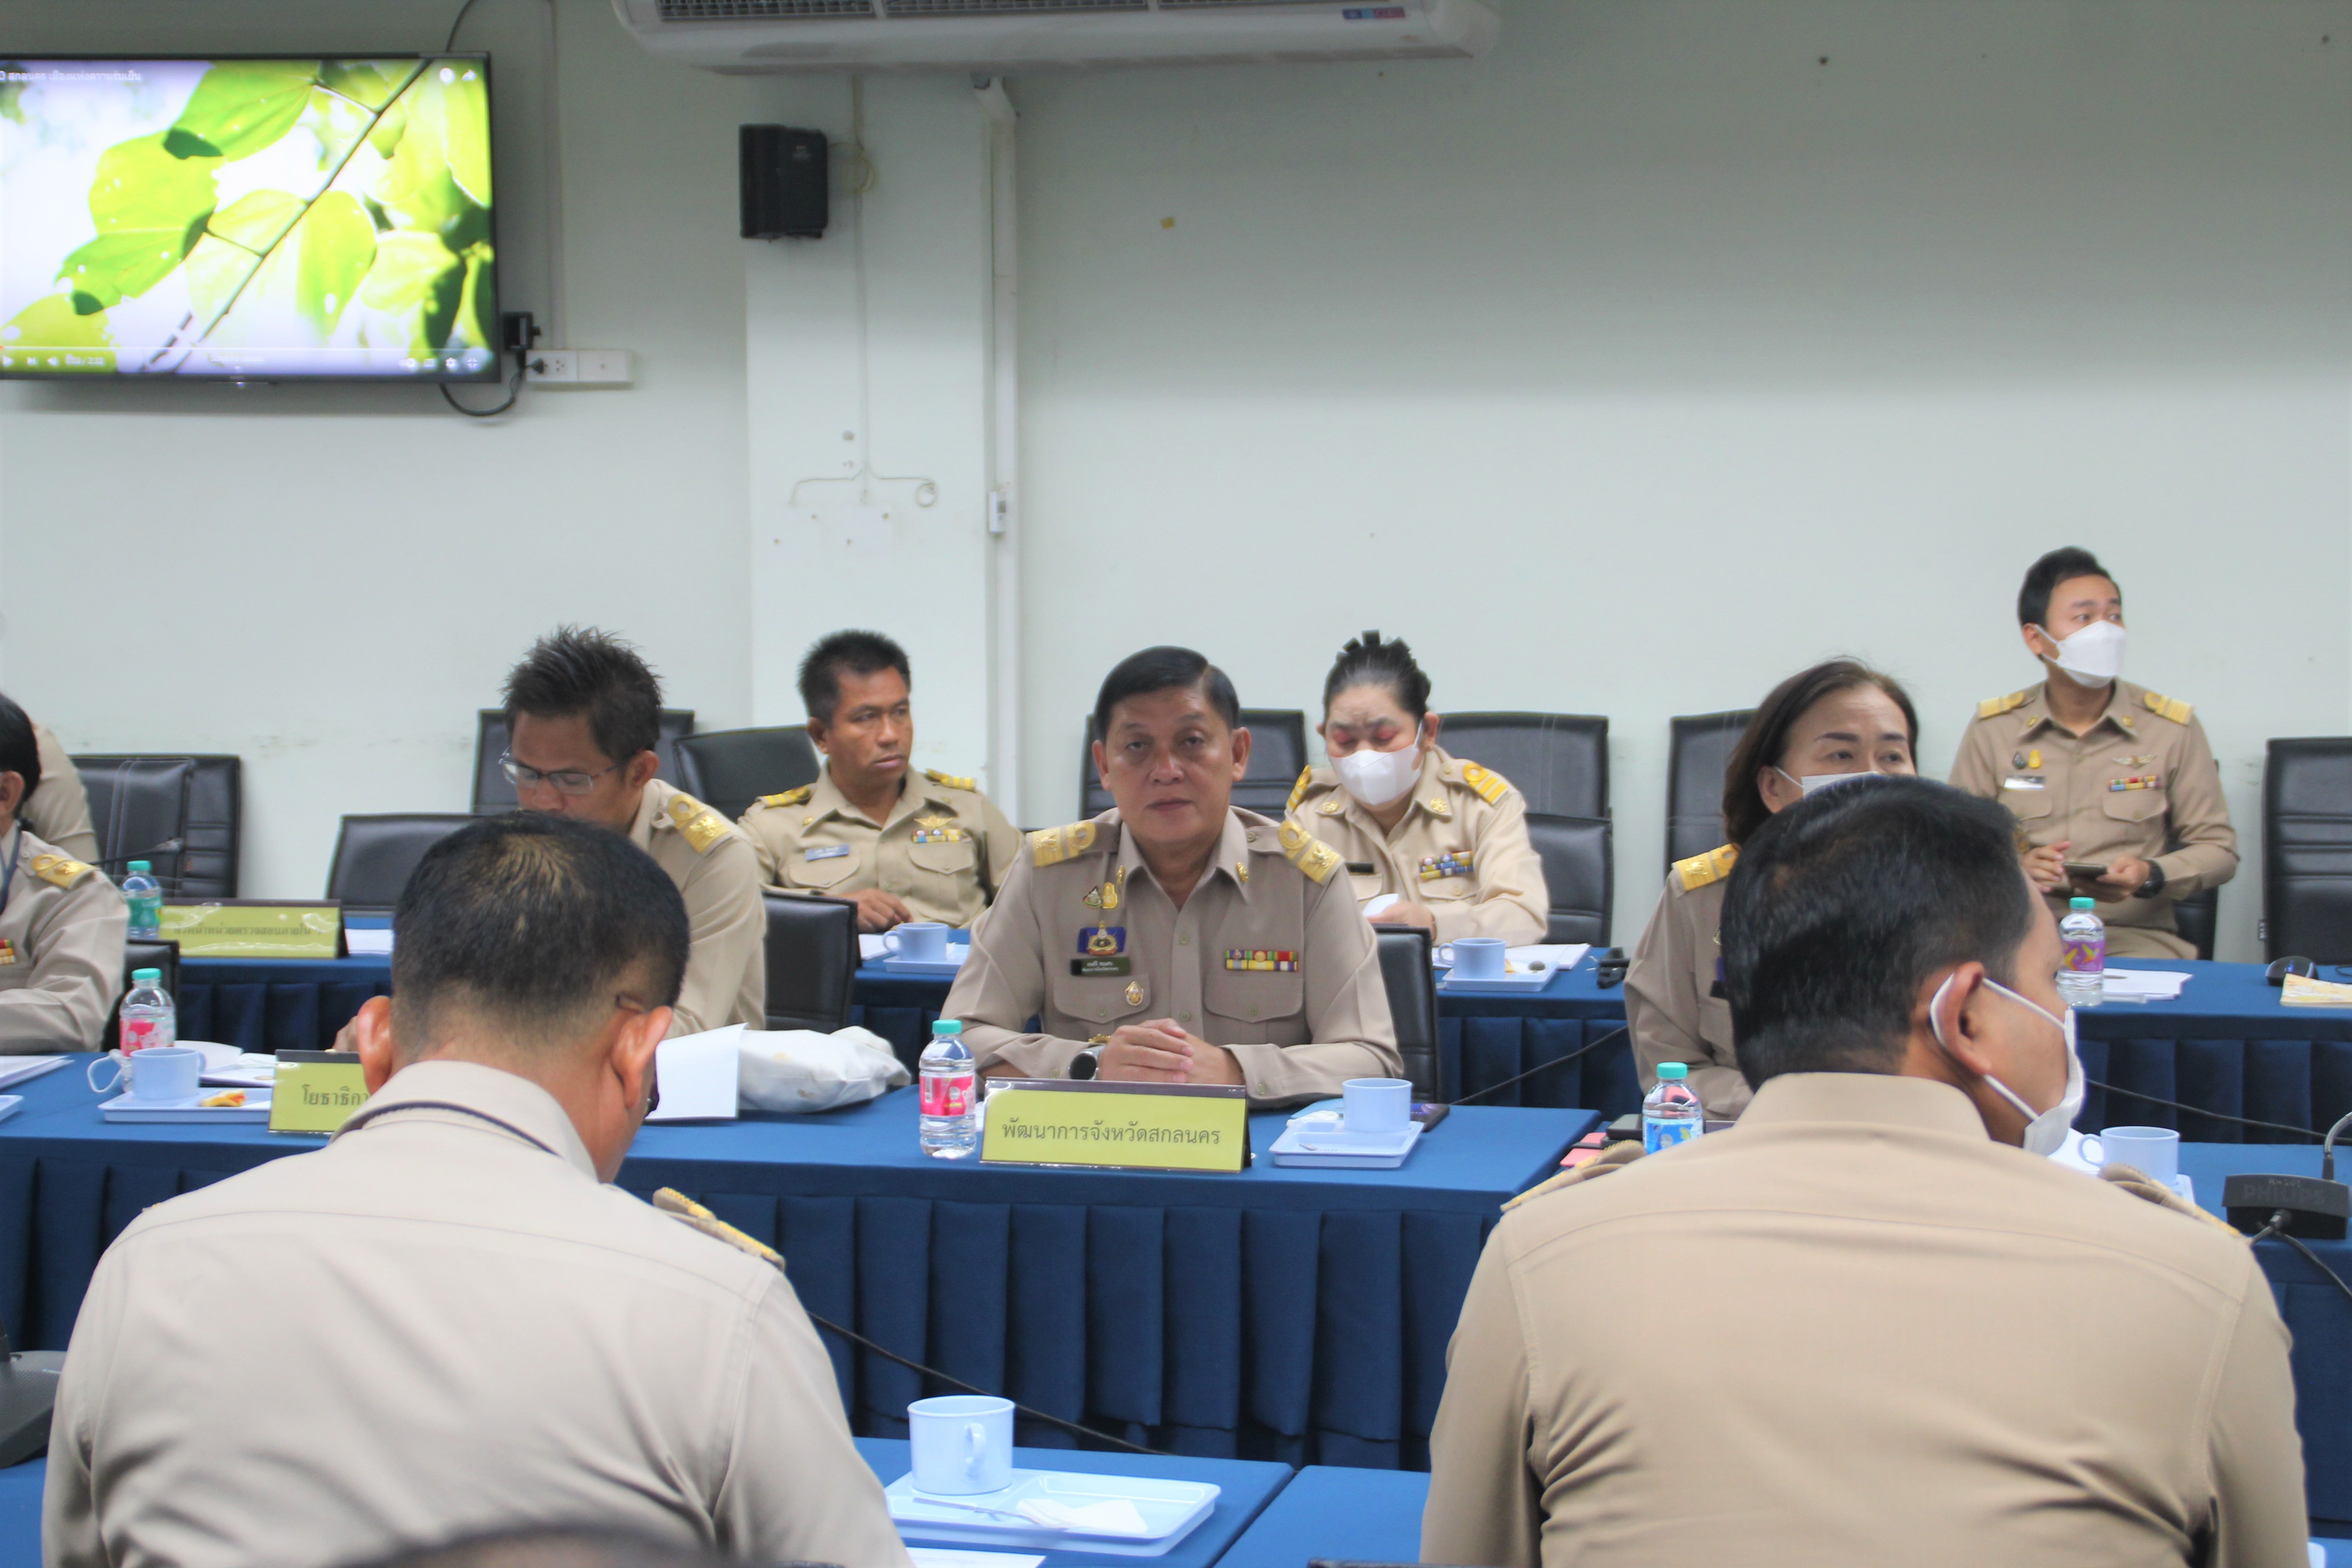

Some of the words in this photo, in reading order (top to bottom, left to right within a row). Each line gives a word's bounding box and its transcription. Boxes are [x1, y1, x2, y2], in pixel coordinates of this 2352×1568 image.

[1002, 1117, 1221, 1145] พัฒนาการจังหวัดสกลนคร
